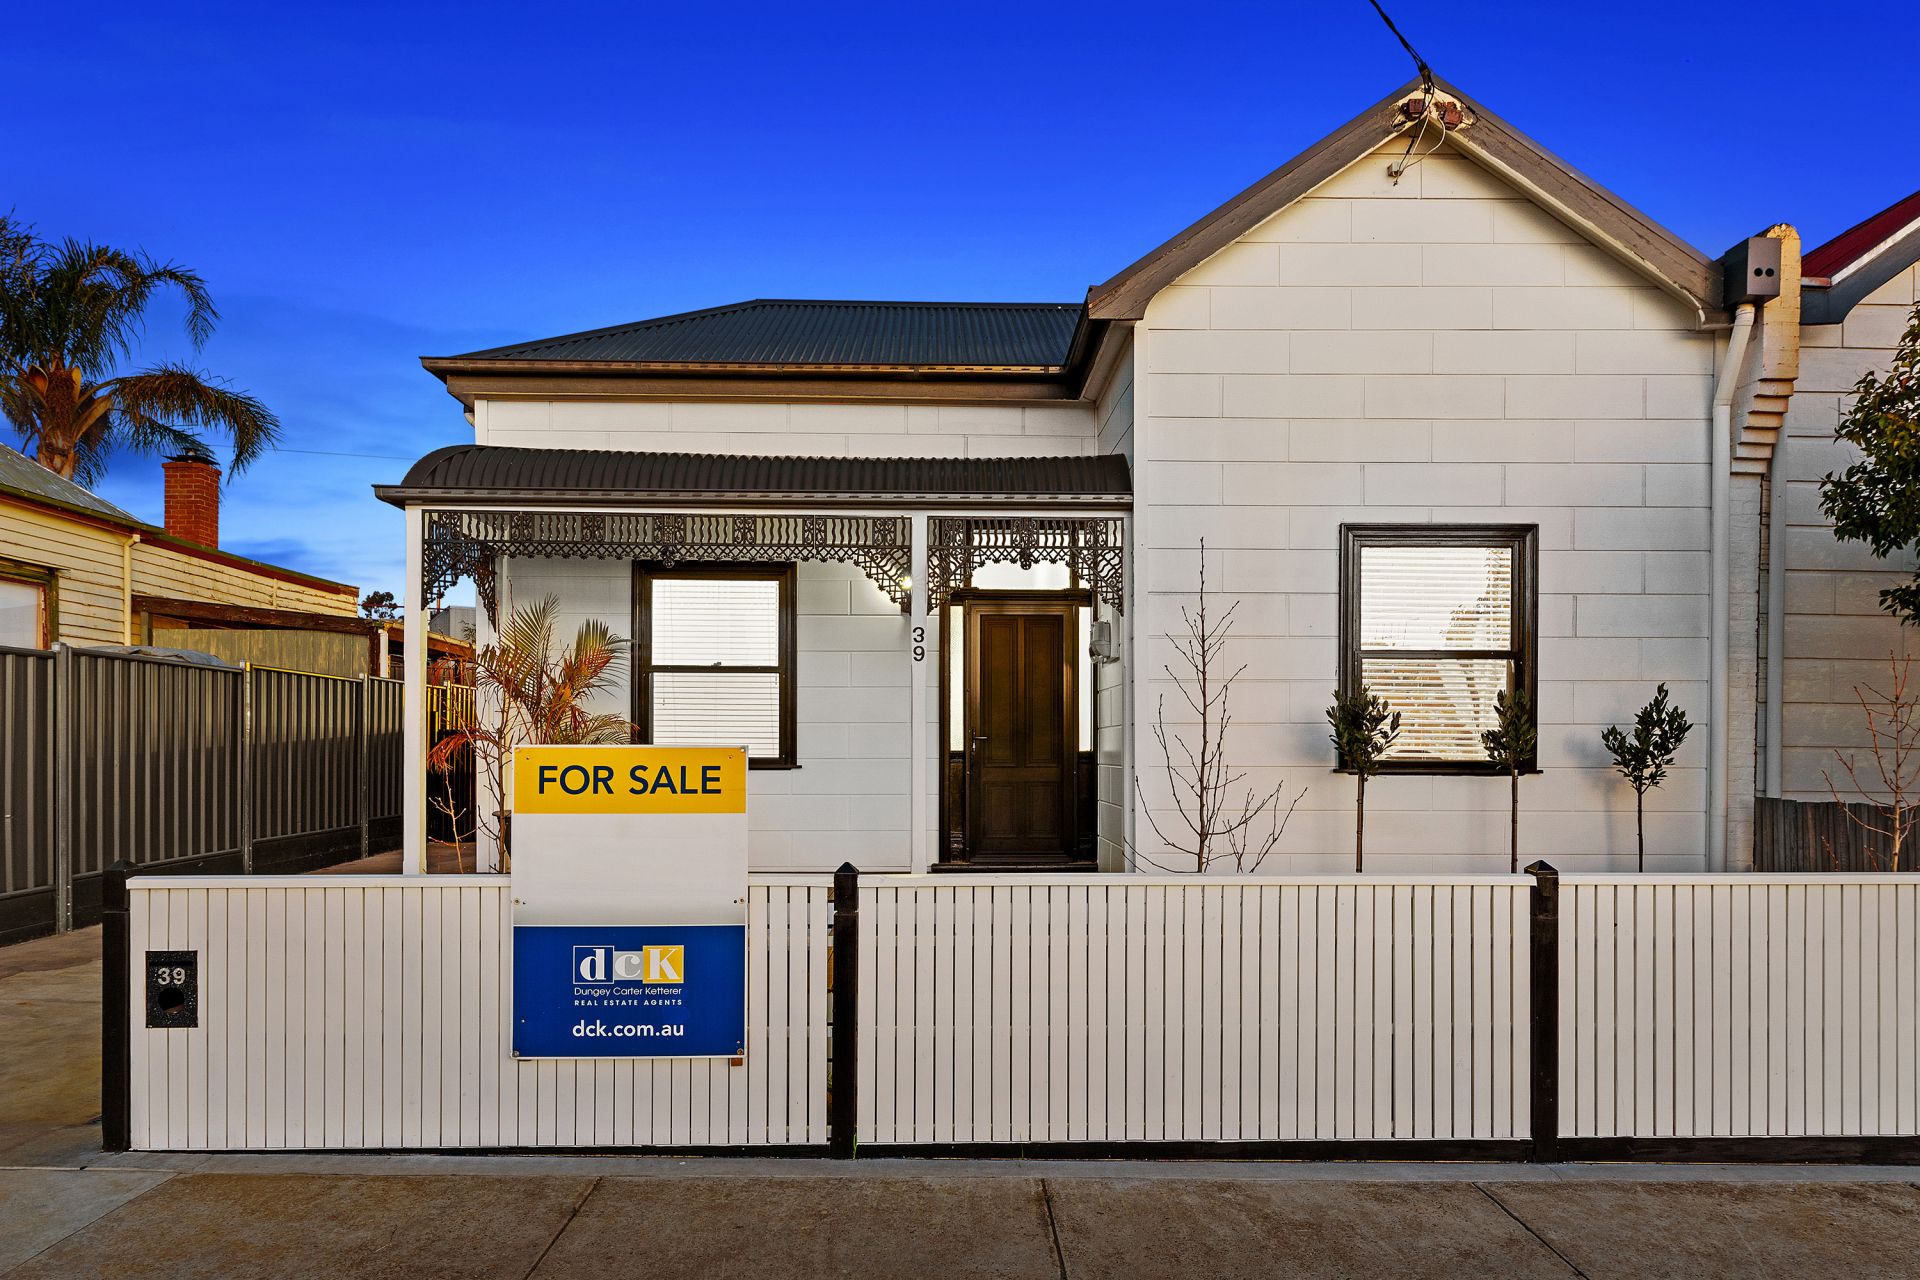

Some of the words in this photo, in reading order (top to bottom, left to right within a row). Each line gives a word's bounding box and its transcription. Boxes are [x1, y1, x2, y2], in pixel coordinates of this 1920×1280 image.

[912, 626, 925, 662] 39
[538, 765, 614, 795] FOR
[628, 765, 722, 795] SALE
[157, 967, 186, 985] 39
[574, 987, 611, 997] Dungey
[613, 987, 643, 996] Carter
[645, 987, 682, 996] Ketterer
[572, 1020, 684, 1037] dck.com.au
